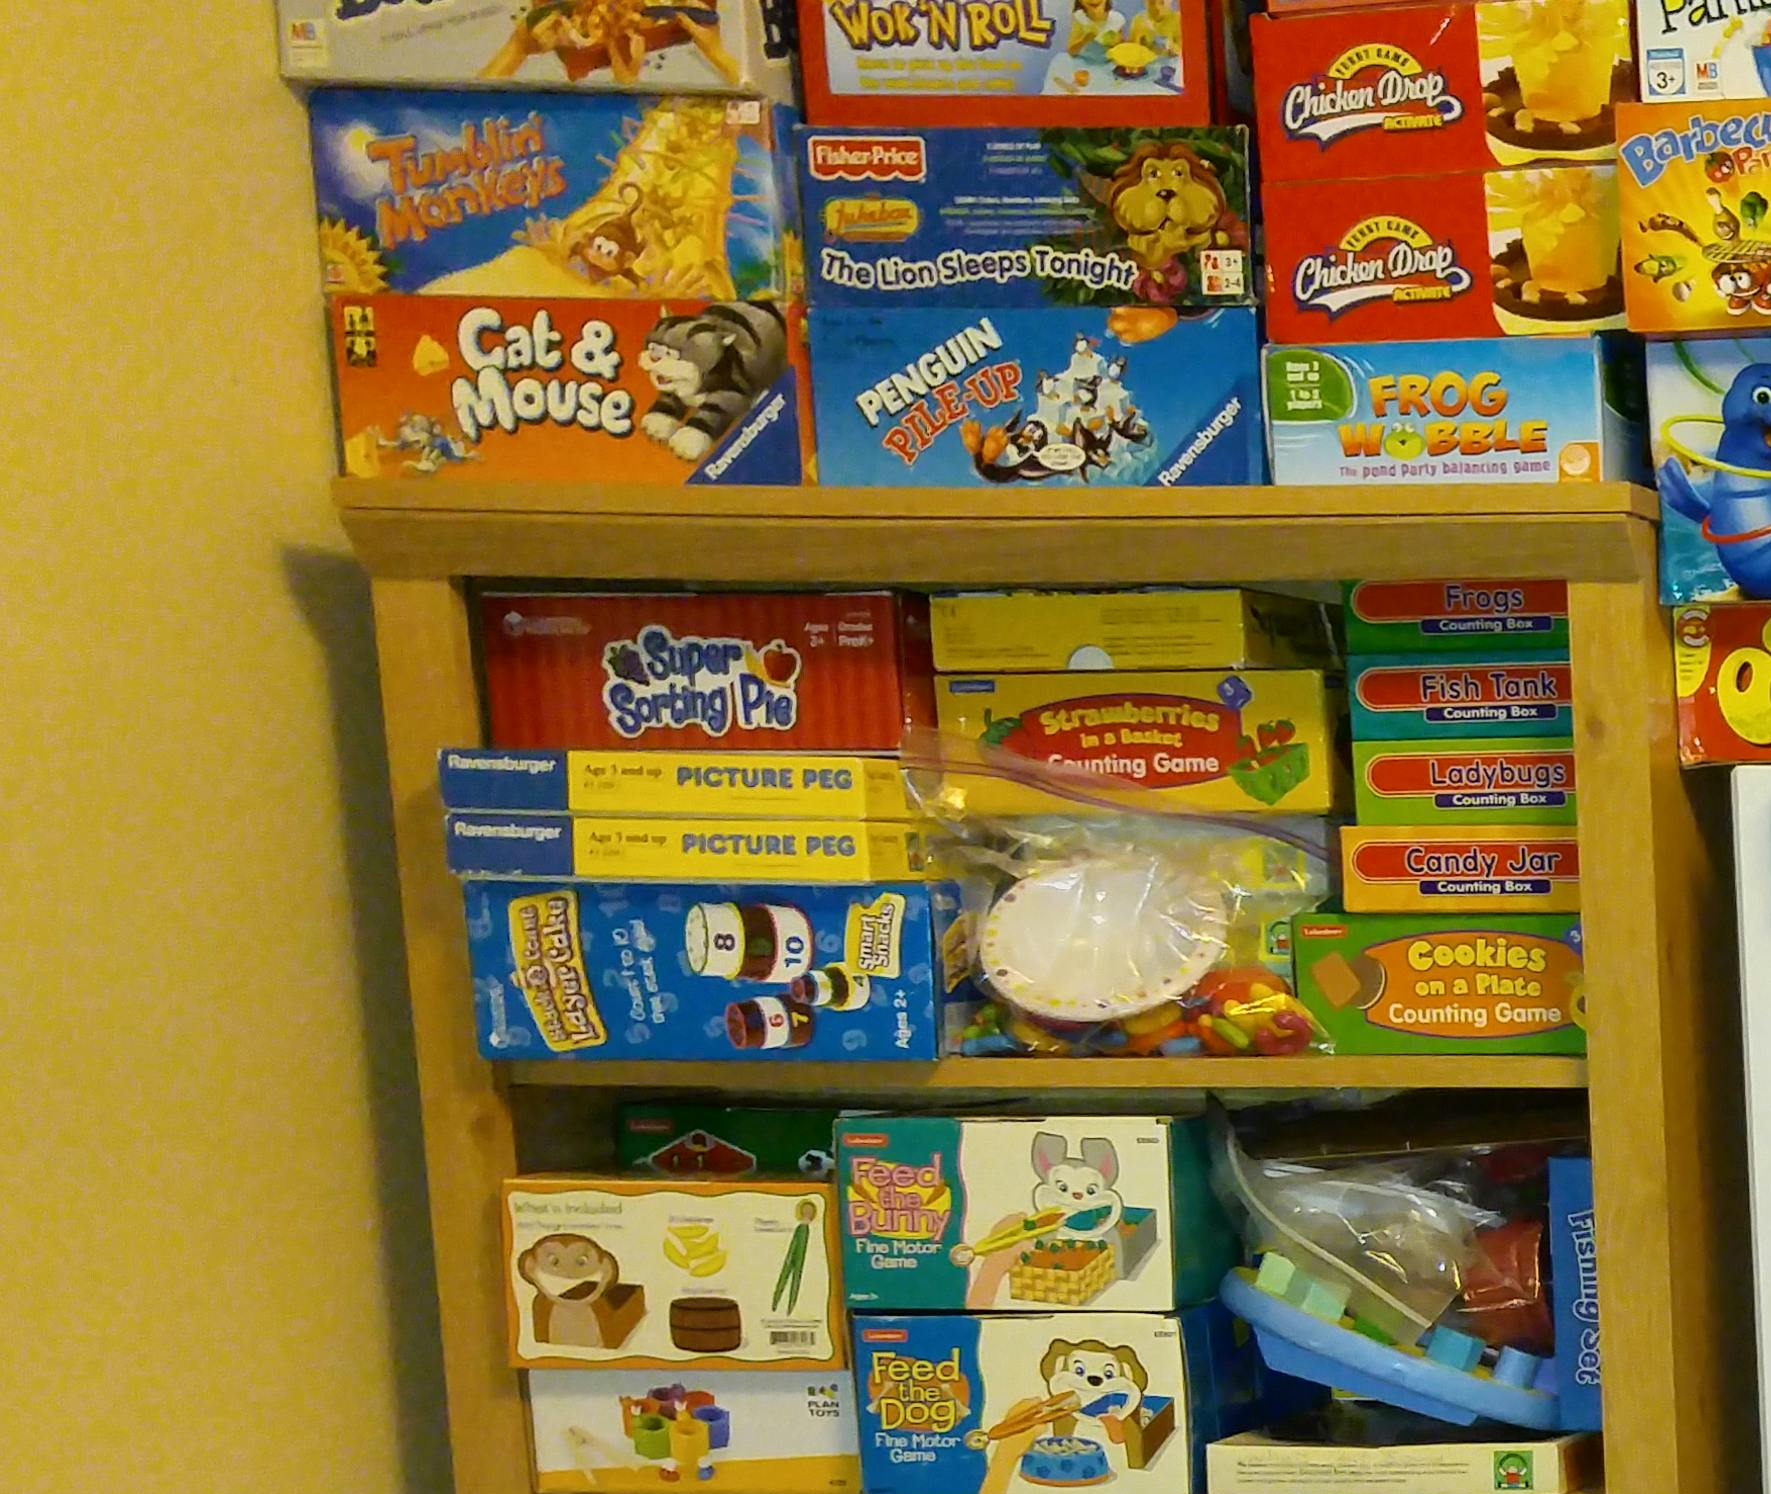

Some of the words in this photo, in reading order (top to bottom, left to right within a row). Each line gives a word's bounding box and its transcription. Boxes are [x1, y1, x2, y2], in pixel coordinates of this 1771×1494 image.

[1285, 78, 1375, 131] Chicken
[1380, 68, 1445, 121] Drop
[820, 250, 874, 285] The
[880, 254, 938, 288] Lion
[944, 252, 1026, 286] Sleeps
[1034, 246, 1138, 292] Tonight
[458, 306, 564, 376] Cat
[572, 319, 621, 379] &
[856, 318, 1004, 426] PENGUIN
[451, 366, 632, 441] Mouse
[1369, 370, 1508, 419] FROG
[883, 361, 1022, 466] PILE-UP
[1444, 584, 1524, 614] Frogs
[1438, 618, 1497, 634] Counting
[1506, 617, 1534, 631] Box
[1420, 674, 1479, 701] Fish
[1493, 672, 1557, 700] Tank
[676, 765, 793, 789] PICTURE
[802, 768, 853, 790] PEG
[1430, 758, 1566, 788] Ladybugs
[1405, 846, 1498, 876] Candy
[1509, 847, 1562, 875] Jar
[1407, 938, 1547, 975] Cookies
[1388, 1001, 1478, 1029] Counting
[1486, 1002, 1562, 1025] Game
[850, 1155, 943, 1188] Feed
[878, 1188, 922, 1209] the
[847, 1202, 950, 1243] Bunny
[870, 1349, 961, 1384] Feed
[899, 1385, 941, 1402] the
[880, 1397, 957, 1432] Dog
